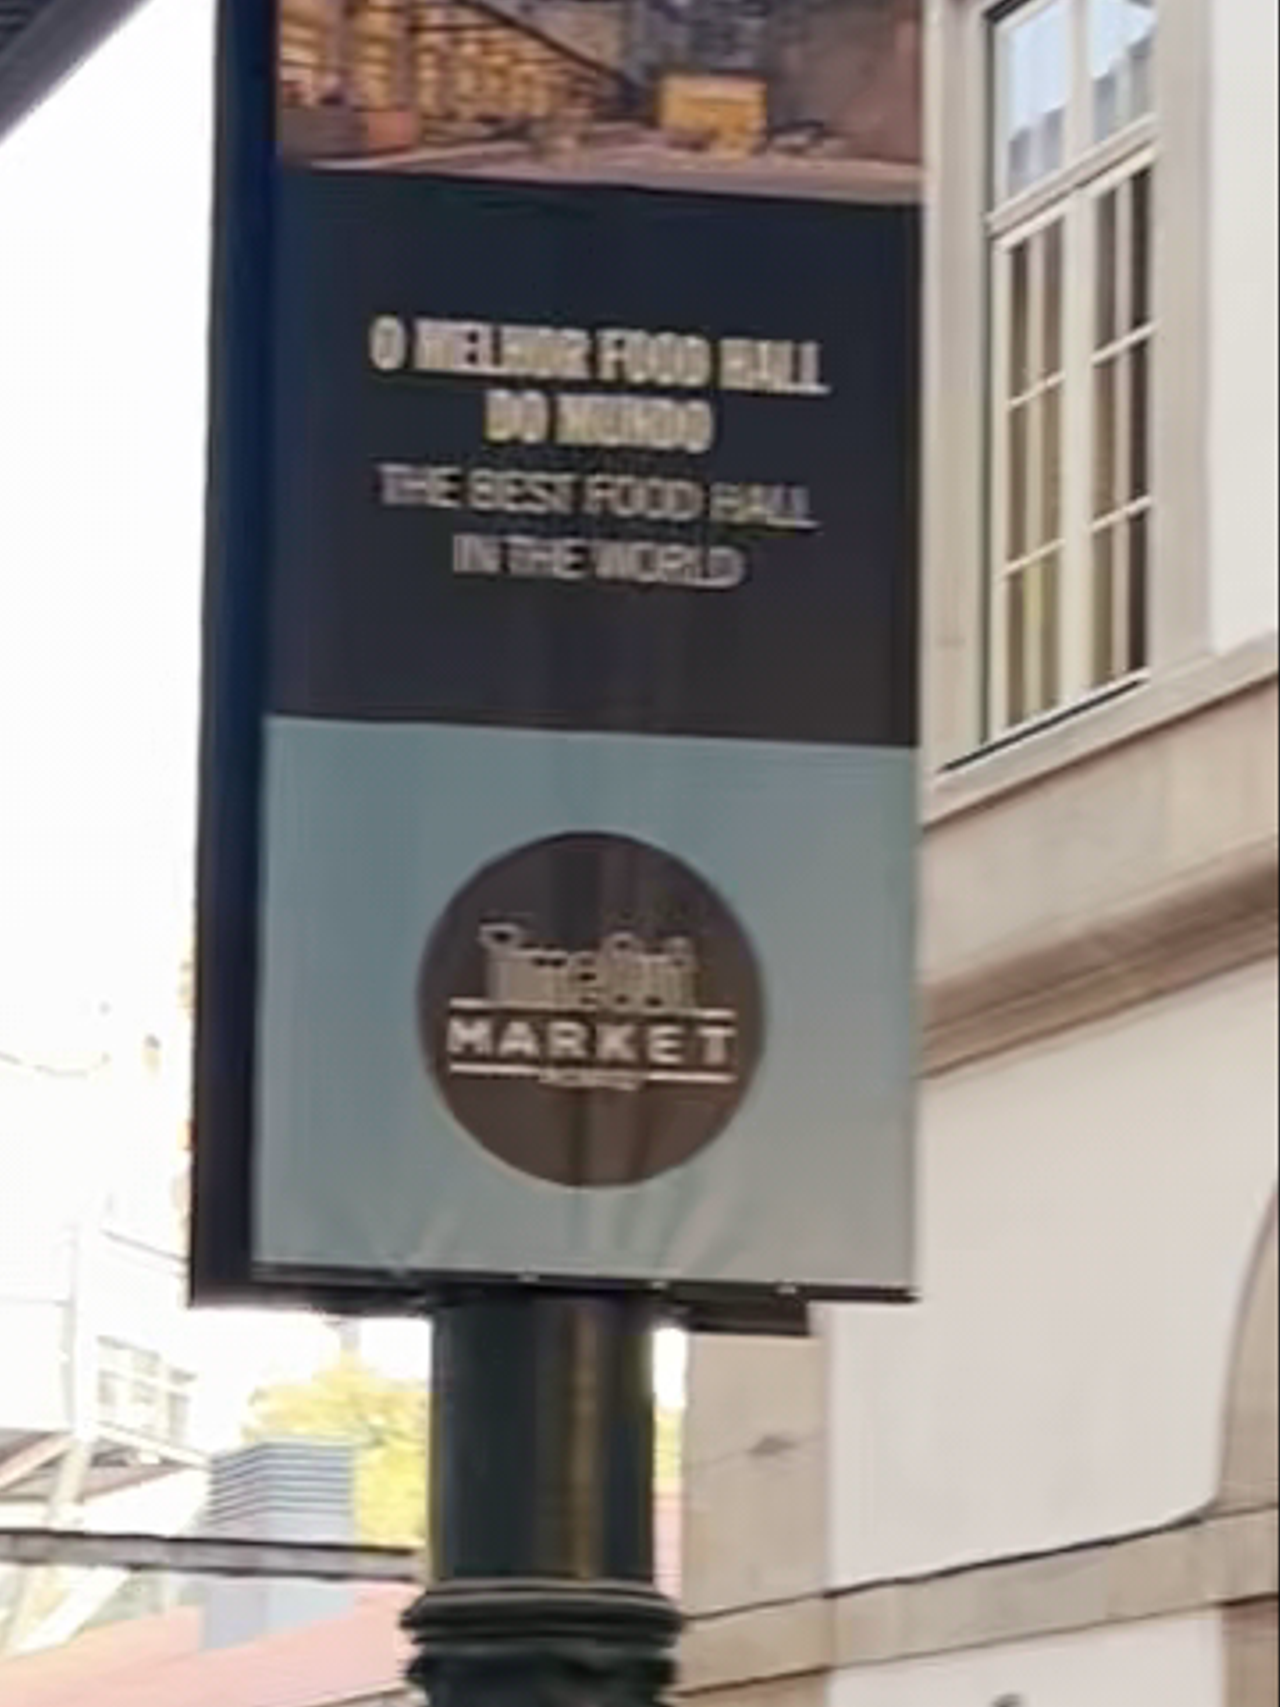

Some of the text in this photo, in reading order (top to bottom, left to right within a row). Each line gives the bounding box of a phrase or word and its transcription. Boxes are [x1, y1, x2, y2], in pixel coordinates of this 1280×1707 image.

[370, 313, 831, 396] O MELHOR FOOD HALL
[484, 389, 713, 454] DO MUNDO
[377, 463, 820, 530] THE BEST FOOD HALL
[452, 533, 746, 588] IN THE WORLD
[448, 1017, 737, 1066] MARKET
